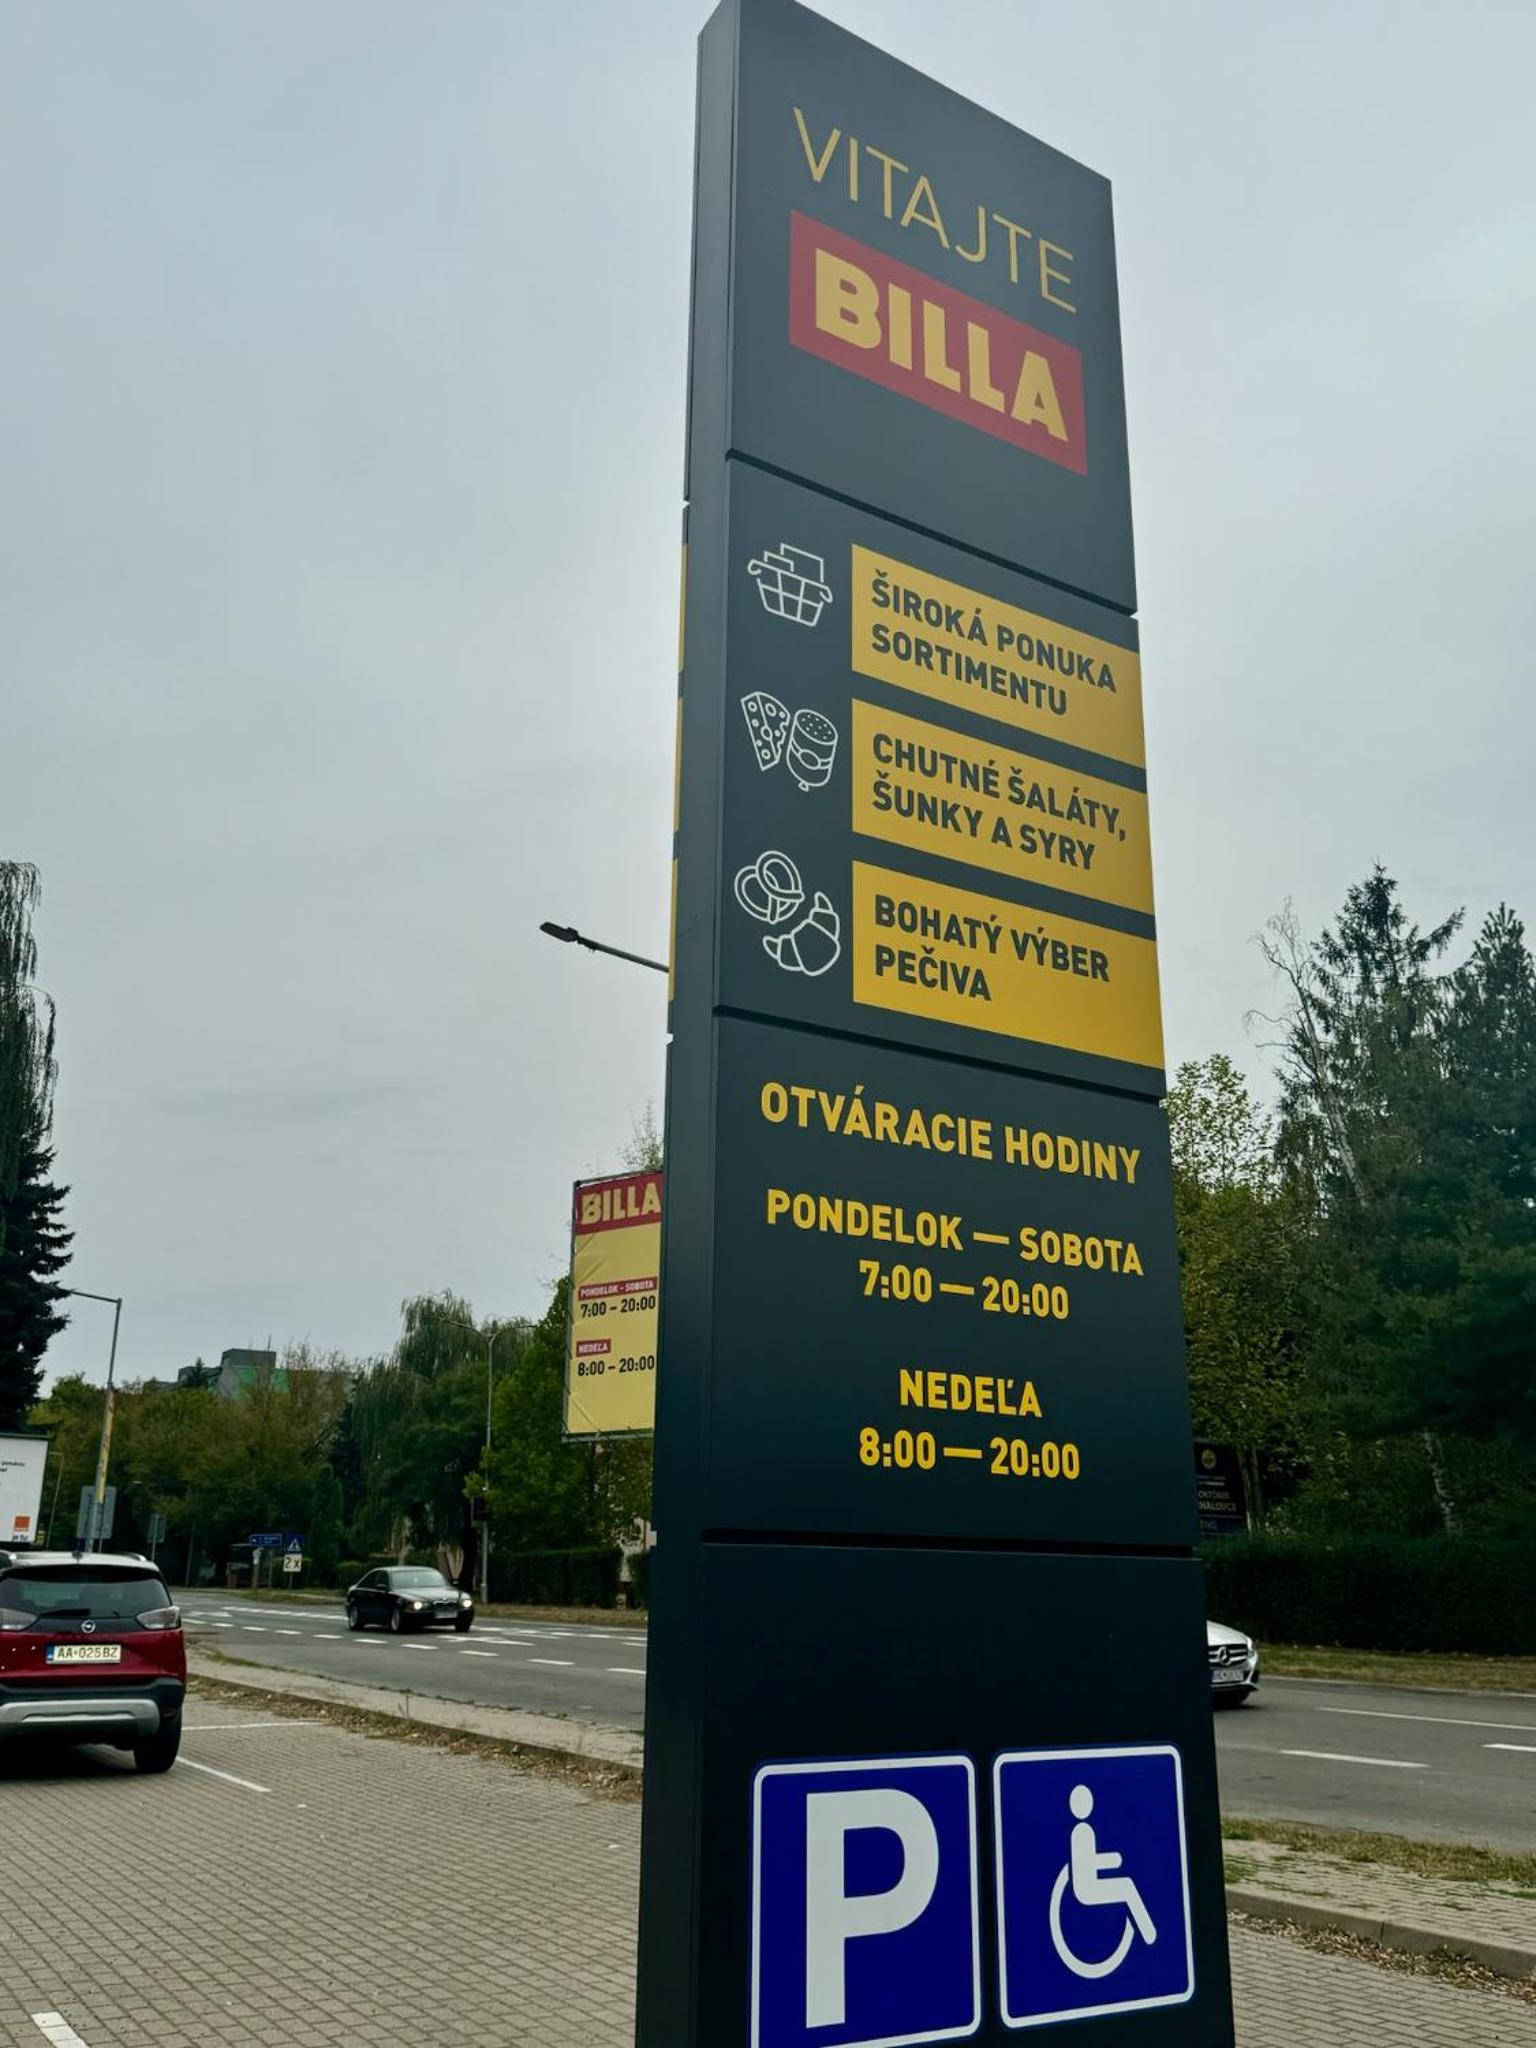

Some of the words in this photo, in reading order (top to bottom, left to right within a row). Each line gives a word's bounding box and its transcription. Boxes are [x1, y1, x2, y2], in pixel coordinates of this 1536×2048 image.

[793, 106, 1077, 314] VITAJTE
[815, 247, 1069, 442] BILLA
[871, 568, 988, 647] ŠIROKÁ
[997, 623, 1117, 693] PONUKA
[871, 624, 1067, 715] SORTIMENTU
[872, 733, 1000, 798] CHUTNÉ
[1008, 767, 1126, 842] ŠALÁTY,
[872, 770, 982, 839] ŠUNKY
[991, 816, 1013, 848] A
[1019, 824, 1095, 870] SYRY
[875, 894, 1002, 954] BOHATÝ
[1011, 926, 1110, 982] VÝBER
[875, 944, 992, 1002] PEČIVA
[760, 1082, 993, 1160] OTVÁRACIE
[1005, 1126, 1141, 1184] HODINY
[581, 1182, 662, 1225] BILLA
[767, 1188, 964, 1250] PONDELOK
[1019, 1227, 1144, 1276] SOBOTA
[581, 1285, 619, 1297] PONDELOK
[625, 1280, 654, 1292] SOBOTA
[581, 1301, 607, 1318] 7:00
[620, 1295, 656, 1313] 20:00
[859, 1259, 933, 1302] 7:00
[982, 1276, 1070, 1320] 20:00
[578, 1360, 605, 1376] 8:00
[619, 1355, 655, 1373] 20:00
[899, 1369, 1043, 1418] NEDEĽA
[859, 1427, 936, 1470] 8:00
[990, 1437, 1080, 1480] 20:00
[806, 1788, 940, 2029] P
